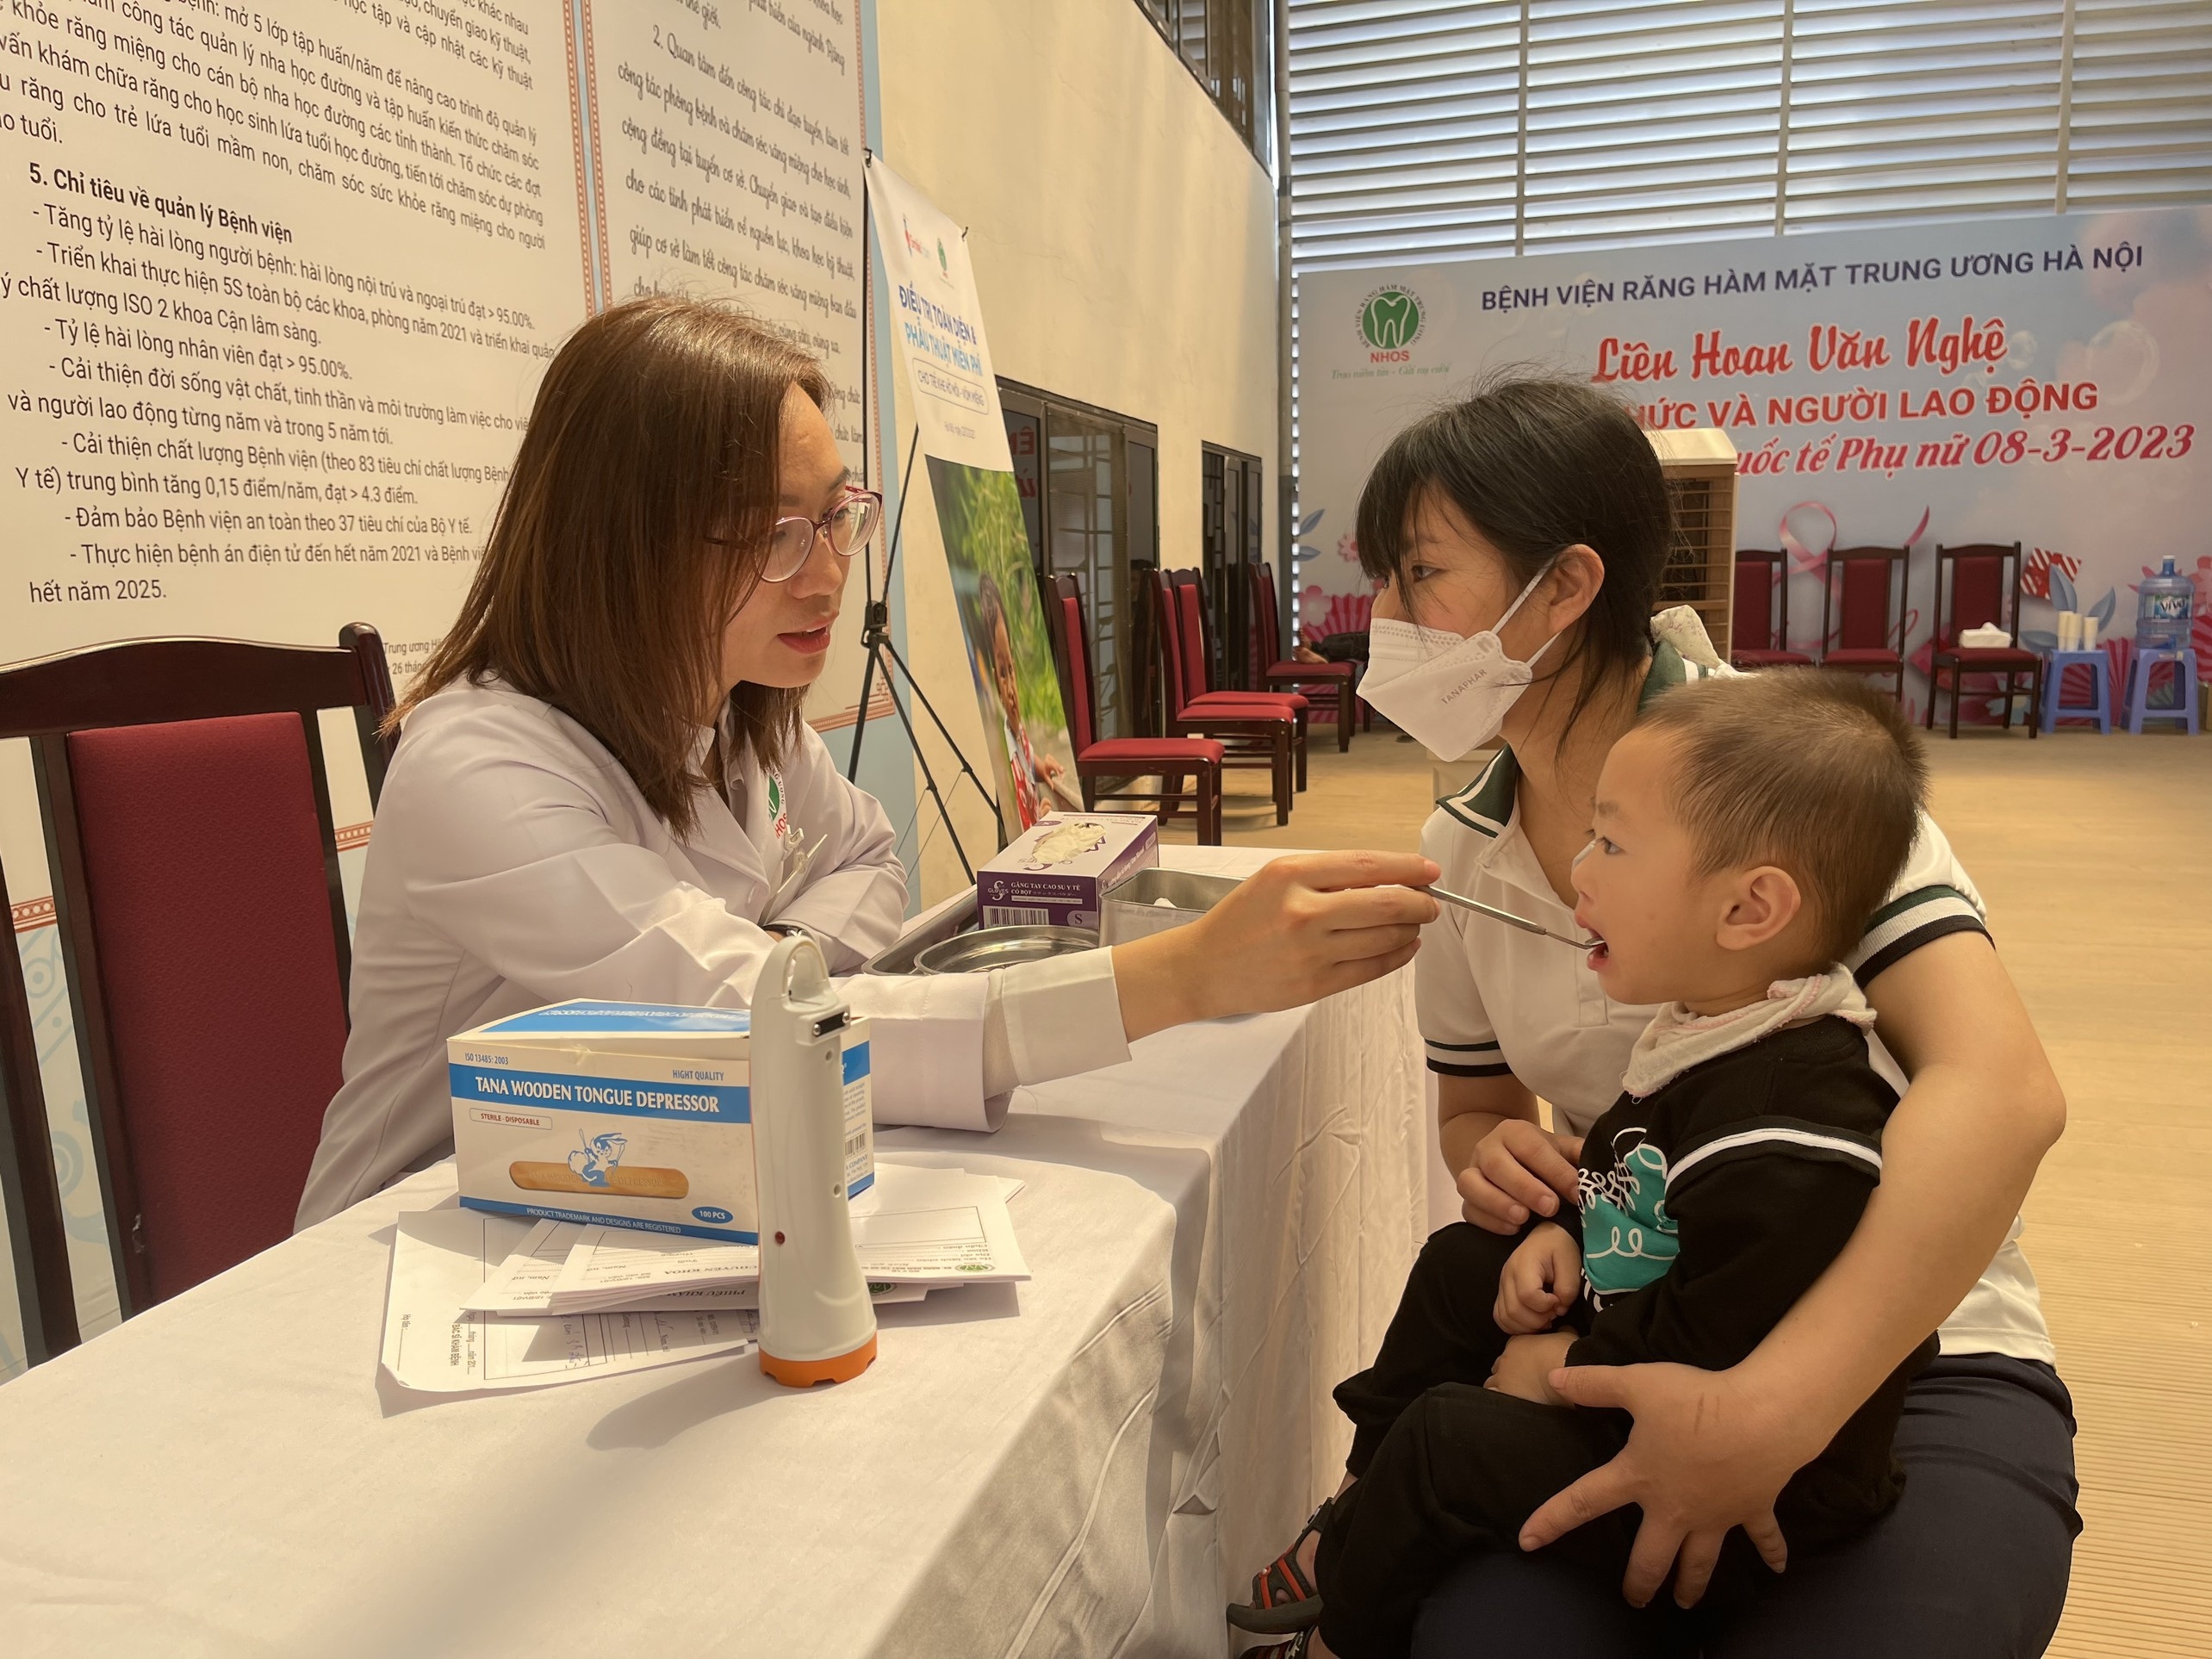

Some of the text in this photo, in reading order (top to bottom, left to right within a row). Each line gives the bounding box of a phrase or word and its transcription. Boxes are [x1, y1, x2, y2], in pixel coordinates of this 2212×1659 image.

[652, 24, 664, 50] 2.
[667, 32, 696, 67] Quan
[29, 161, 293, 245] 5. Chỉ tiêu về quản lý Bệnh viện
[629, 224, 653, 259] giúp
[1482, 241, 2143, 314] BỆNH VIỆN RĂNG HÀM MẶT TRUNG ƯƠNG HÀ NỘI
[17, 275, 321, 348] chất lượng ISO 2 khoa Cận lâm sàng.
[1370, 351, 1411, 363] NHOS
[1591, 315, 2009, 384] Liên Hoan Văn Nghệ
[7, 388, 394, 445] và người lao động từng năm và trong 5 năm tới.
[1624, 377, 2099, 430] HỨC VÀ NGƯỜI LAO ĐỘNG
[1737, 424, 2196, 479] uốc tế Phụ nữ 08-3-2023
[15, 465, 419, 505] Y tế) trung bình tăng 0,15 điểm/năm, đạt > 4.3 điểm.
[75, 504, 473, 537] Đảm bảo Bệnh viện an toàn theo 37 tiêu chí của Bộ Y tế.
[28, 579, 167, 604] hết năm 2025.
[1441, 668, 1488, 705] TANAPHAR
[1074, 914, 1083, 924] S
[465, 1053, 509, 1066] ISO 13485: 2003
[672, 1070, 724, 1081] HIGHT QUALITY
[475, 1076, 720, 1113] TANA WOODEN TONGUE DEPRESSOR
[481, 1112, 540, 1126] STERILE DISPOSABLE
[526, 1208, 681, 1234] PRODUCT TRADEMARK AND DESIGNS ARE REGISTERED
[699, 1209, 725, 1221] 100 PCS
